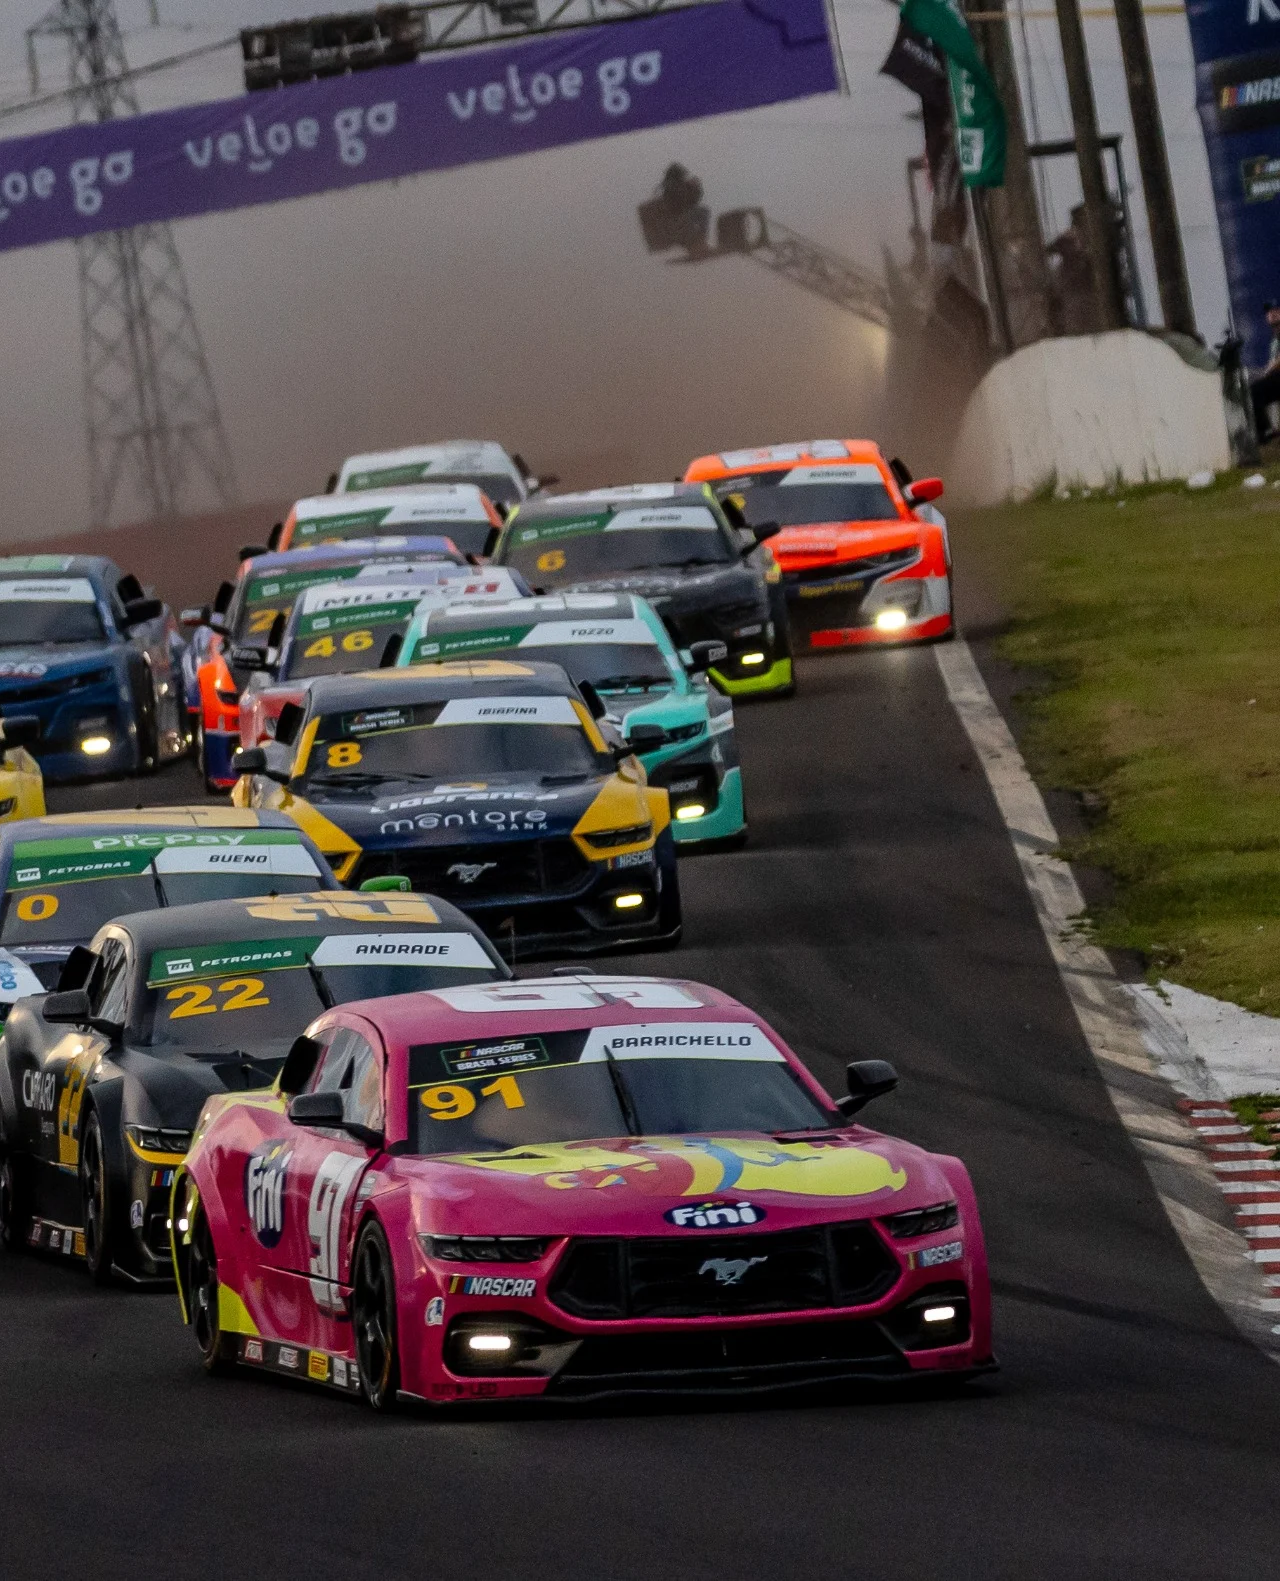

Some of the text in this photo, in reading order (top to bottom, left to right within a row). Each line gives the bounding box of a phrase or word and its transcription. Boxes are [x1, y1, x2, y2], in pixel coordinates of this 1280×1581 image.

[448, 51, 661, 123] veloe go
[185, 100, 397, 173] veloe go
[69, 151, 133, 215] go
[537, 549, 566, 572] 6
[304, 630, 374, 658] 46
[327, 742, 362, 767] 8
[380, 809, 547, 835] mentore
[497, 822, 547, 832] BANK
[48, 861, 132, 876] PETROBRAS
[208, 854, 268, 864] BUENO
[16, 893, 59, 922] 0
[201, 950, 293, 967] PETROBRAS
[355, 943, 450, 956] ANDRADE
[166, 978, 270, 1020] 22
[474, 1042, 525, 1057] NASCAR
[611, 1035, 751, 1049] BARRICHELLO
[456, 1052, 536, 1071] BRASIL SERIES
[420, 1076, 526, 1121] 91
[671, 1202, 758, 1228] Fini
[921, 1243, 963, 1267] NASCAR
[468, 1277, 537, 1297] NASCAR
